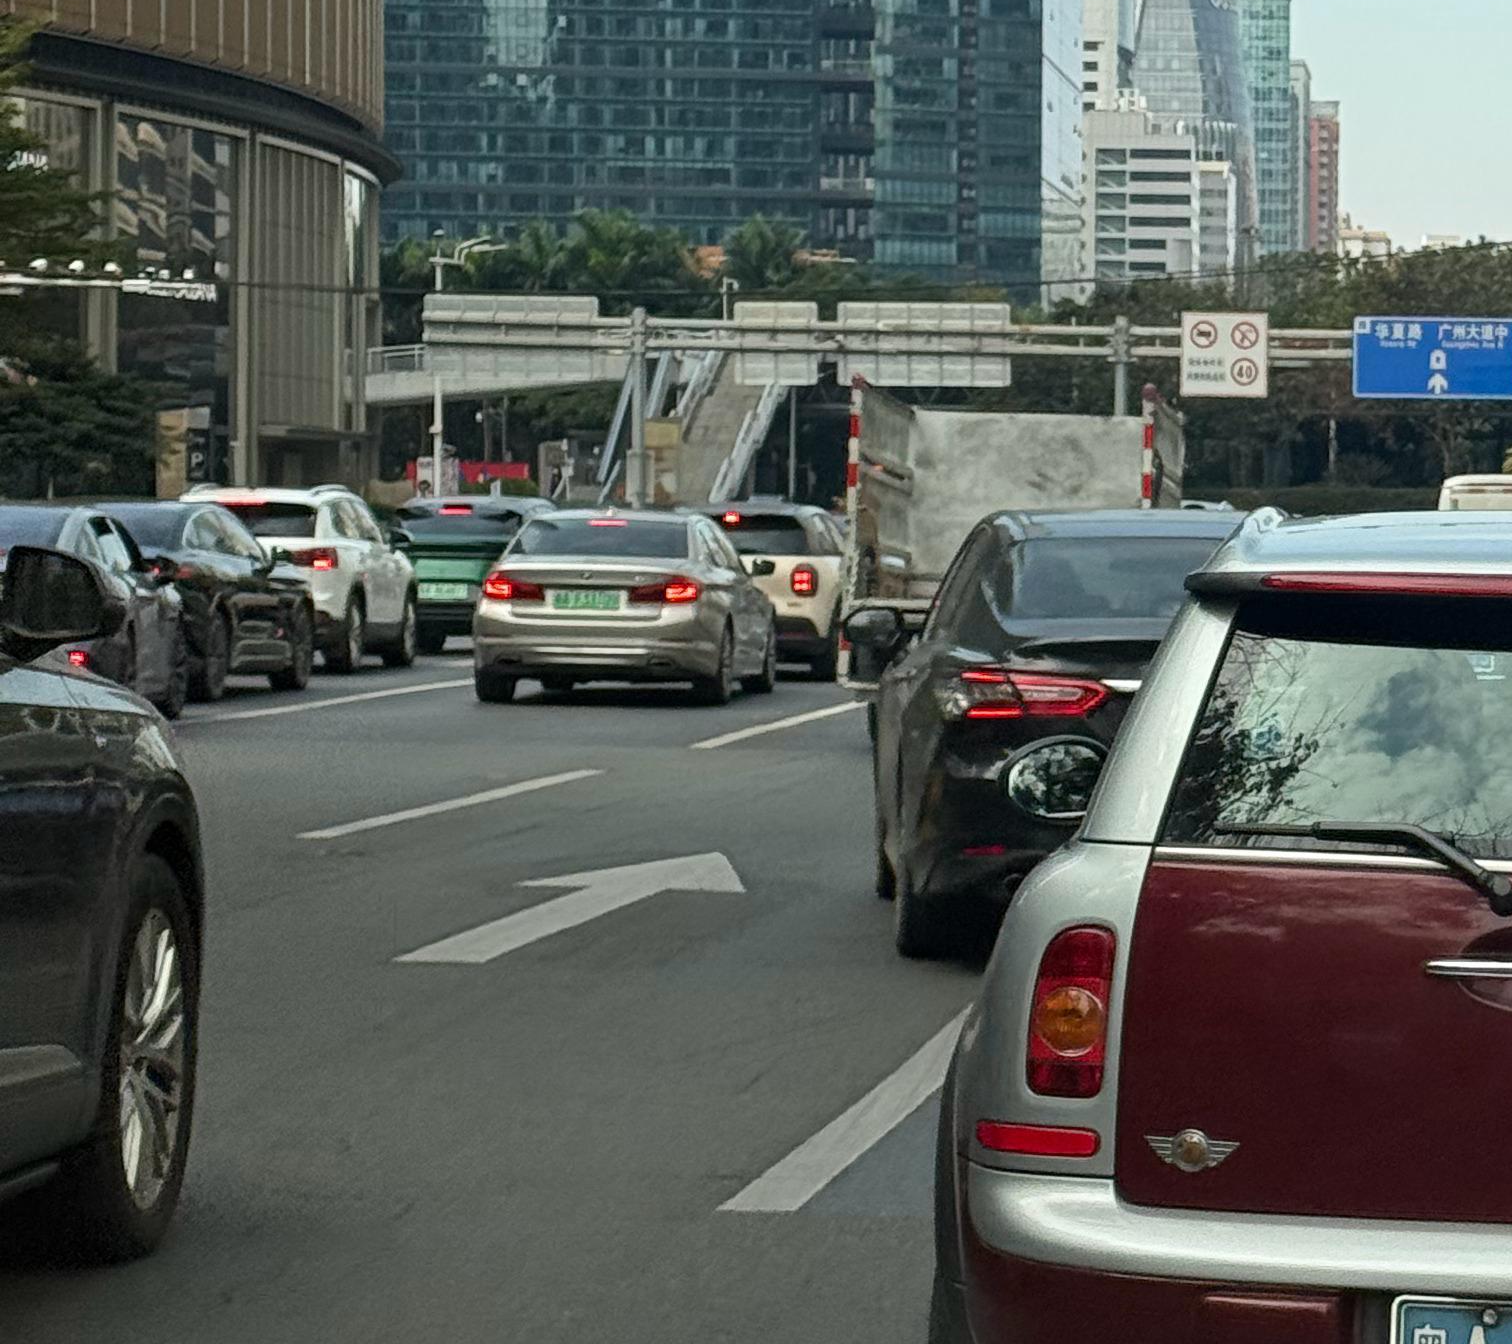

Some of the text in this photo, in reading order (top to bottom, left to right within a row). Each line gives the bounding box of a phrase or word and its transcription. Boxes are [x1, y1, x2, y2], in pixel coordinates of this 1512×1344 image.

[1438, 324, 1509, 342] 广州大道中
[1237, 365, 1252, 379] 40
